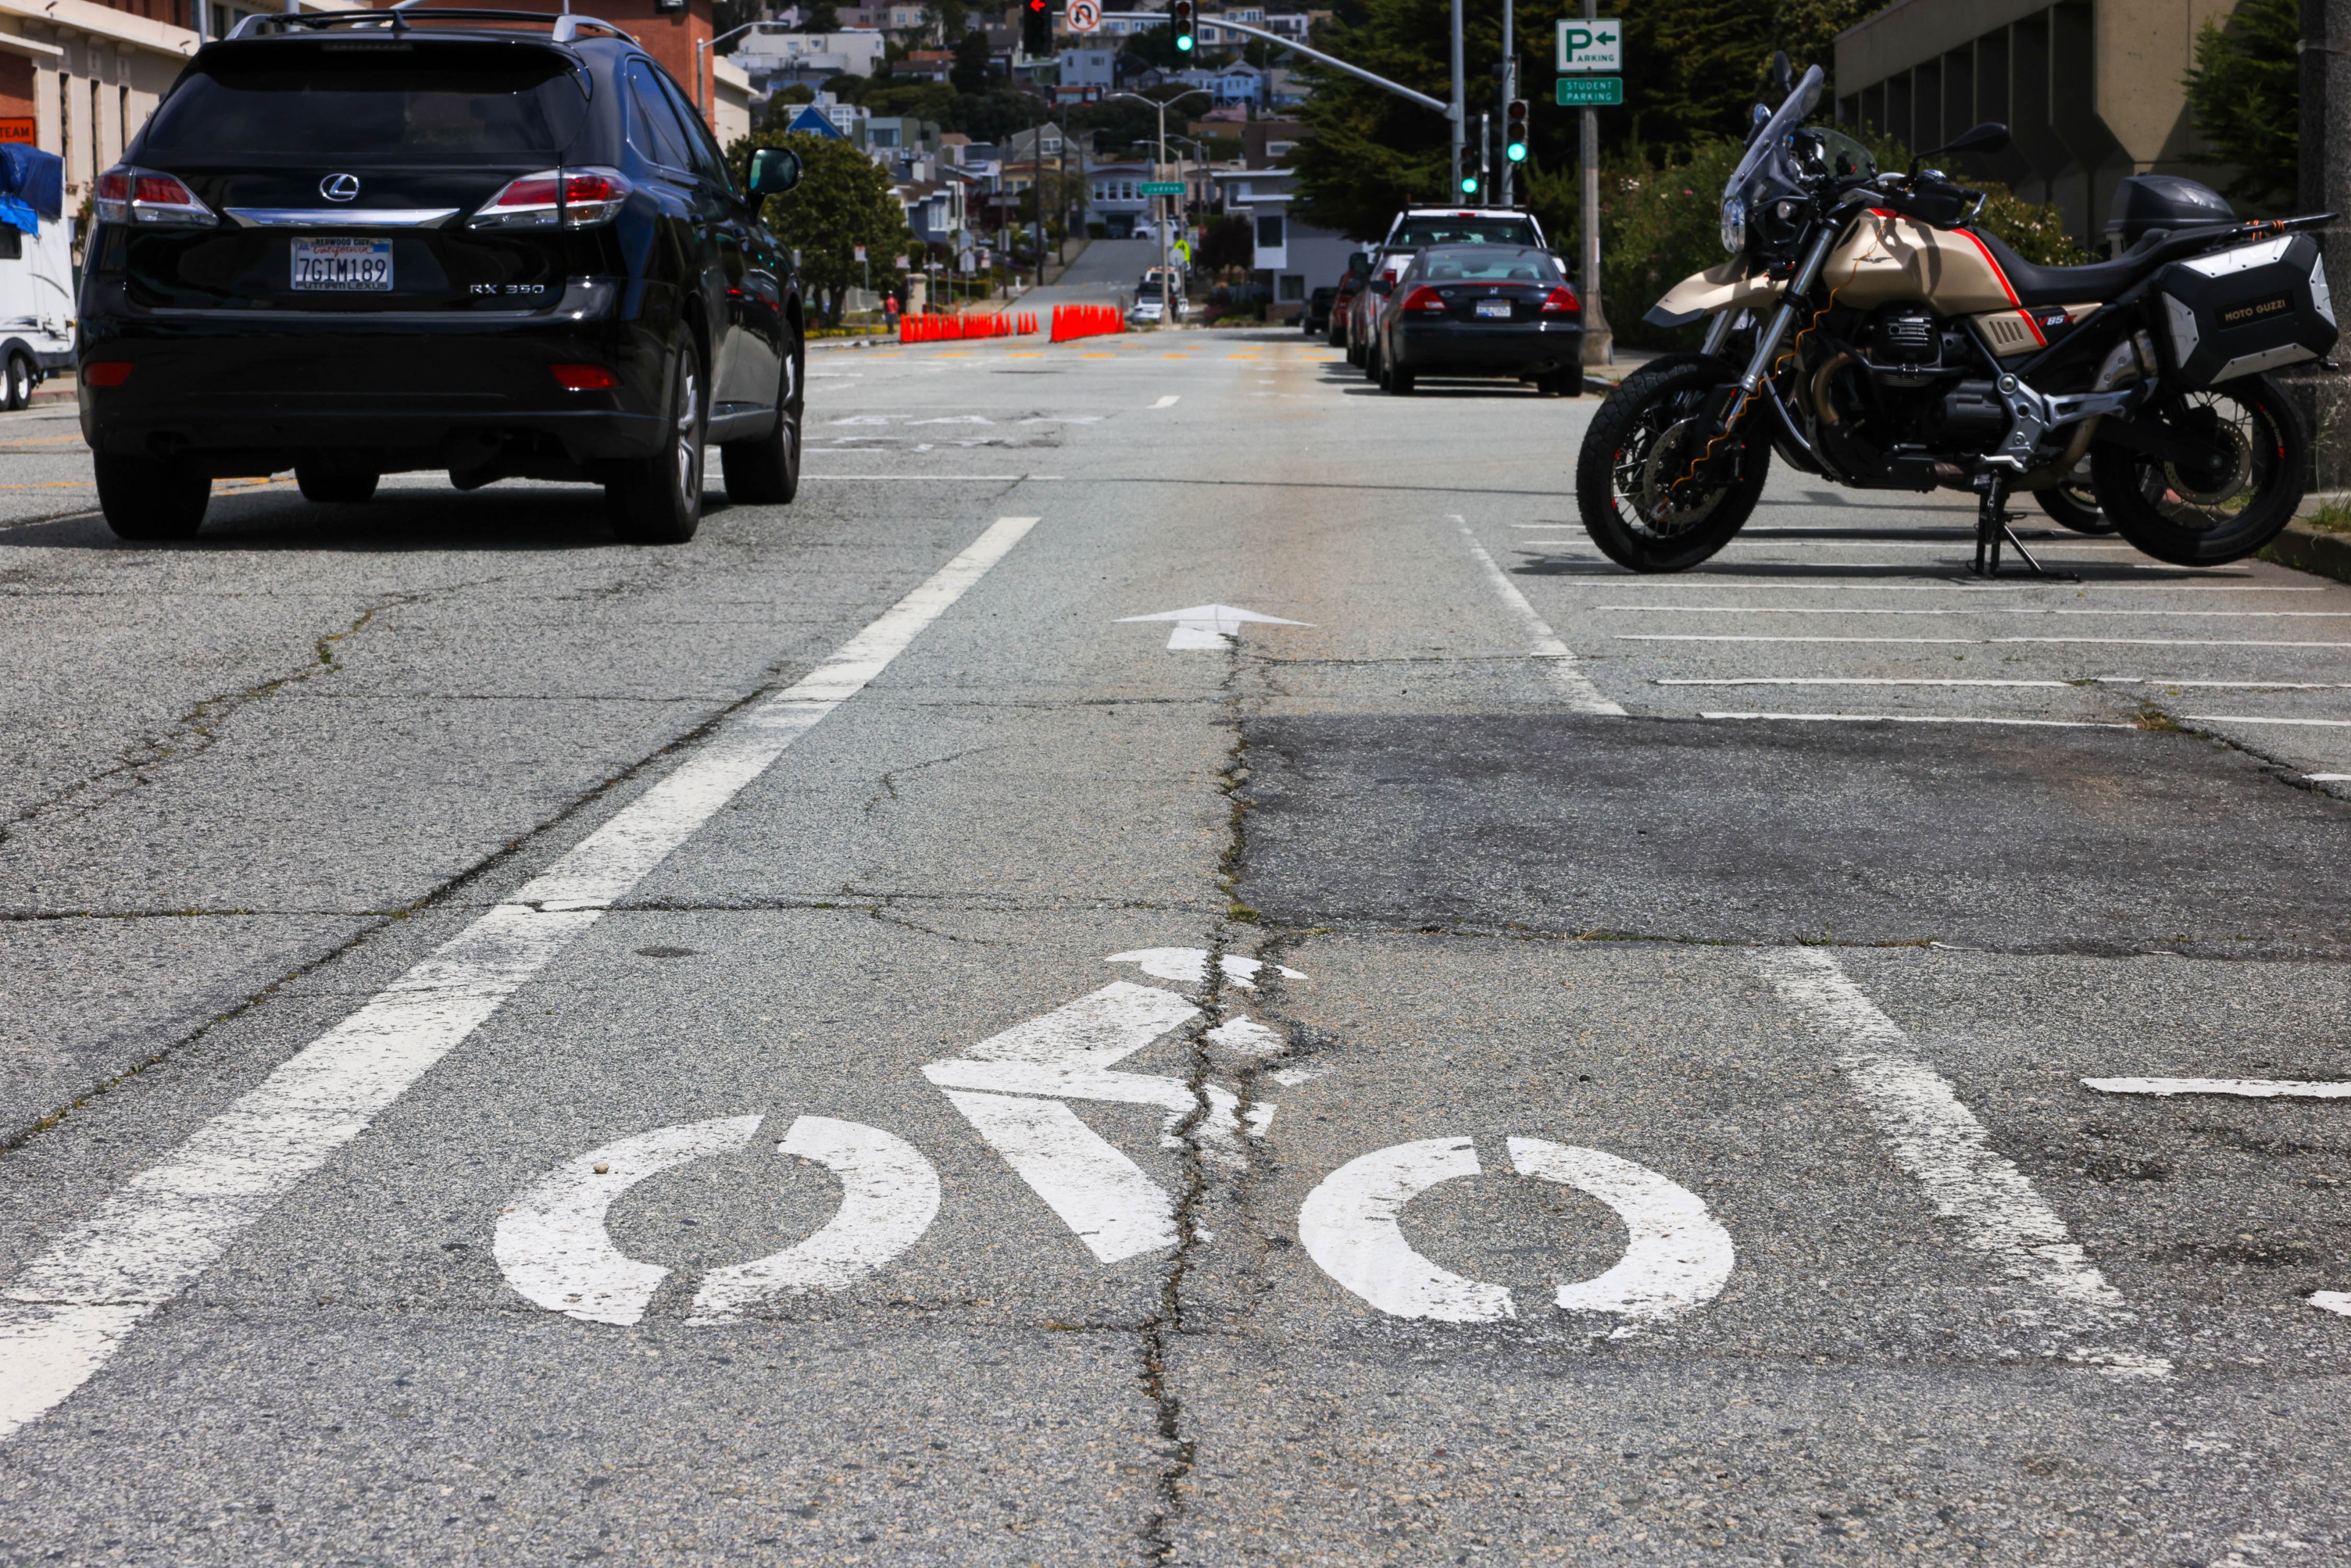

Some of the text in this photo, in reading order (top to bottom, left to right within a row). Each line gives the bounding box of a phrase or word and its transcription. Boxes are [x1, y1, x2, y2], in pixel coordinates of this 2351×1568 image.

[1567, 81, 1612, 90] STUDENT
[1567, 92, 1612, 101] PARKING
[313, 246, 374, 257] California
[299, 258, 386, 282] 7GIM189
[470, 284, 544, 294] RX 350
[2225, 299, 2286, 321] MOTO GUZZI
